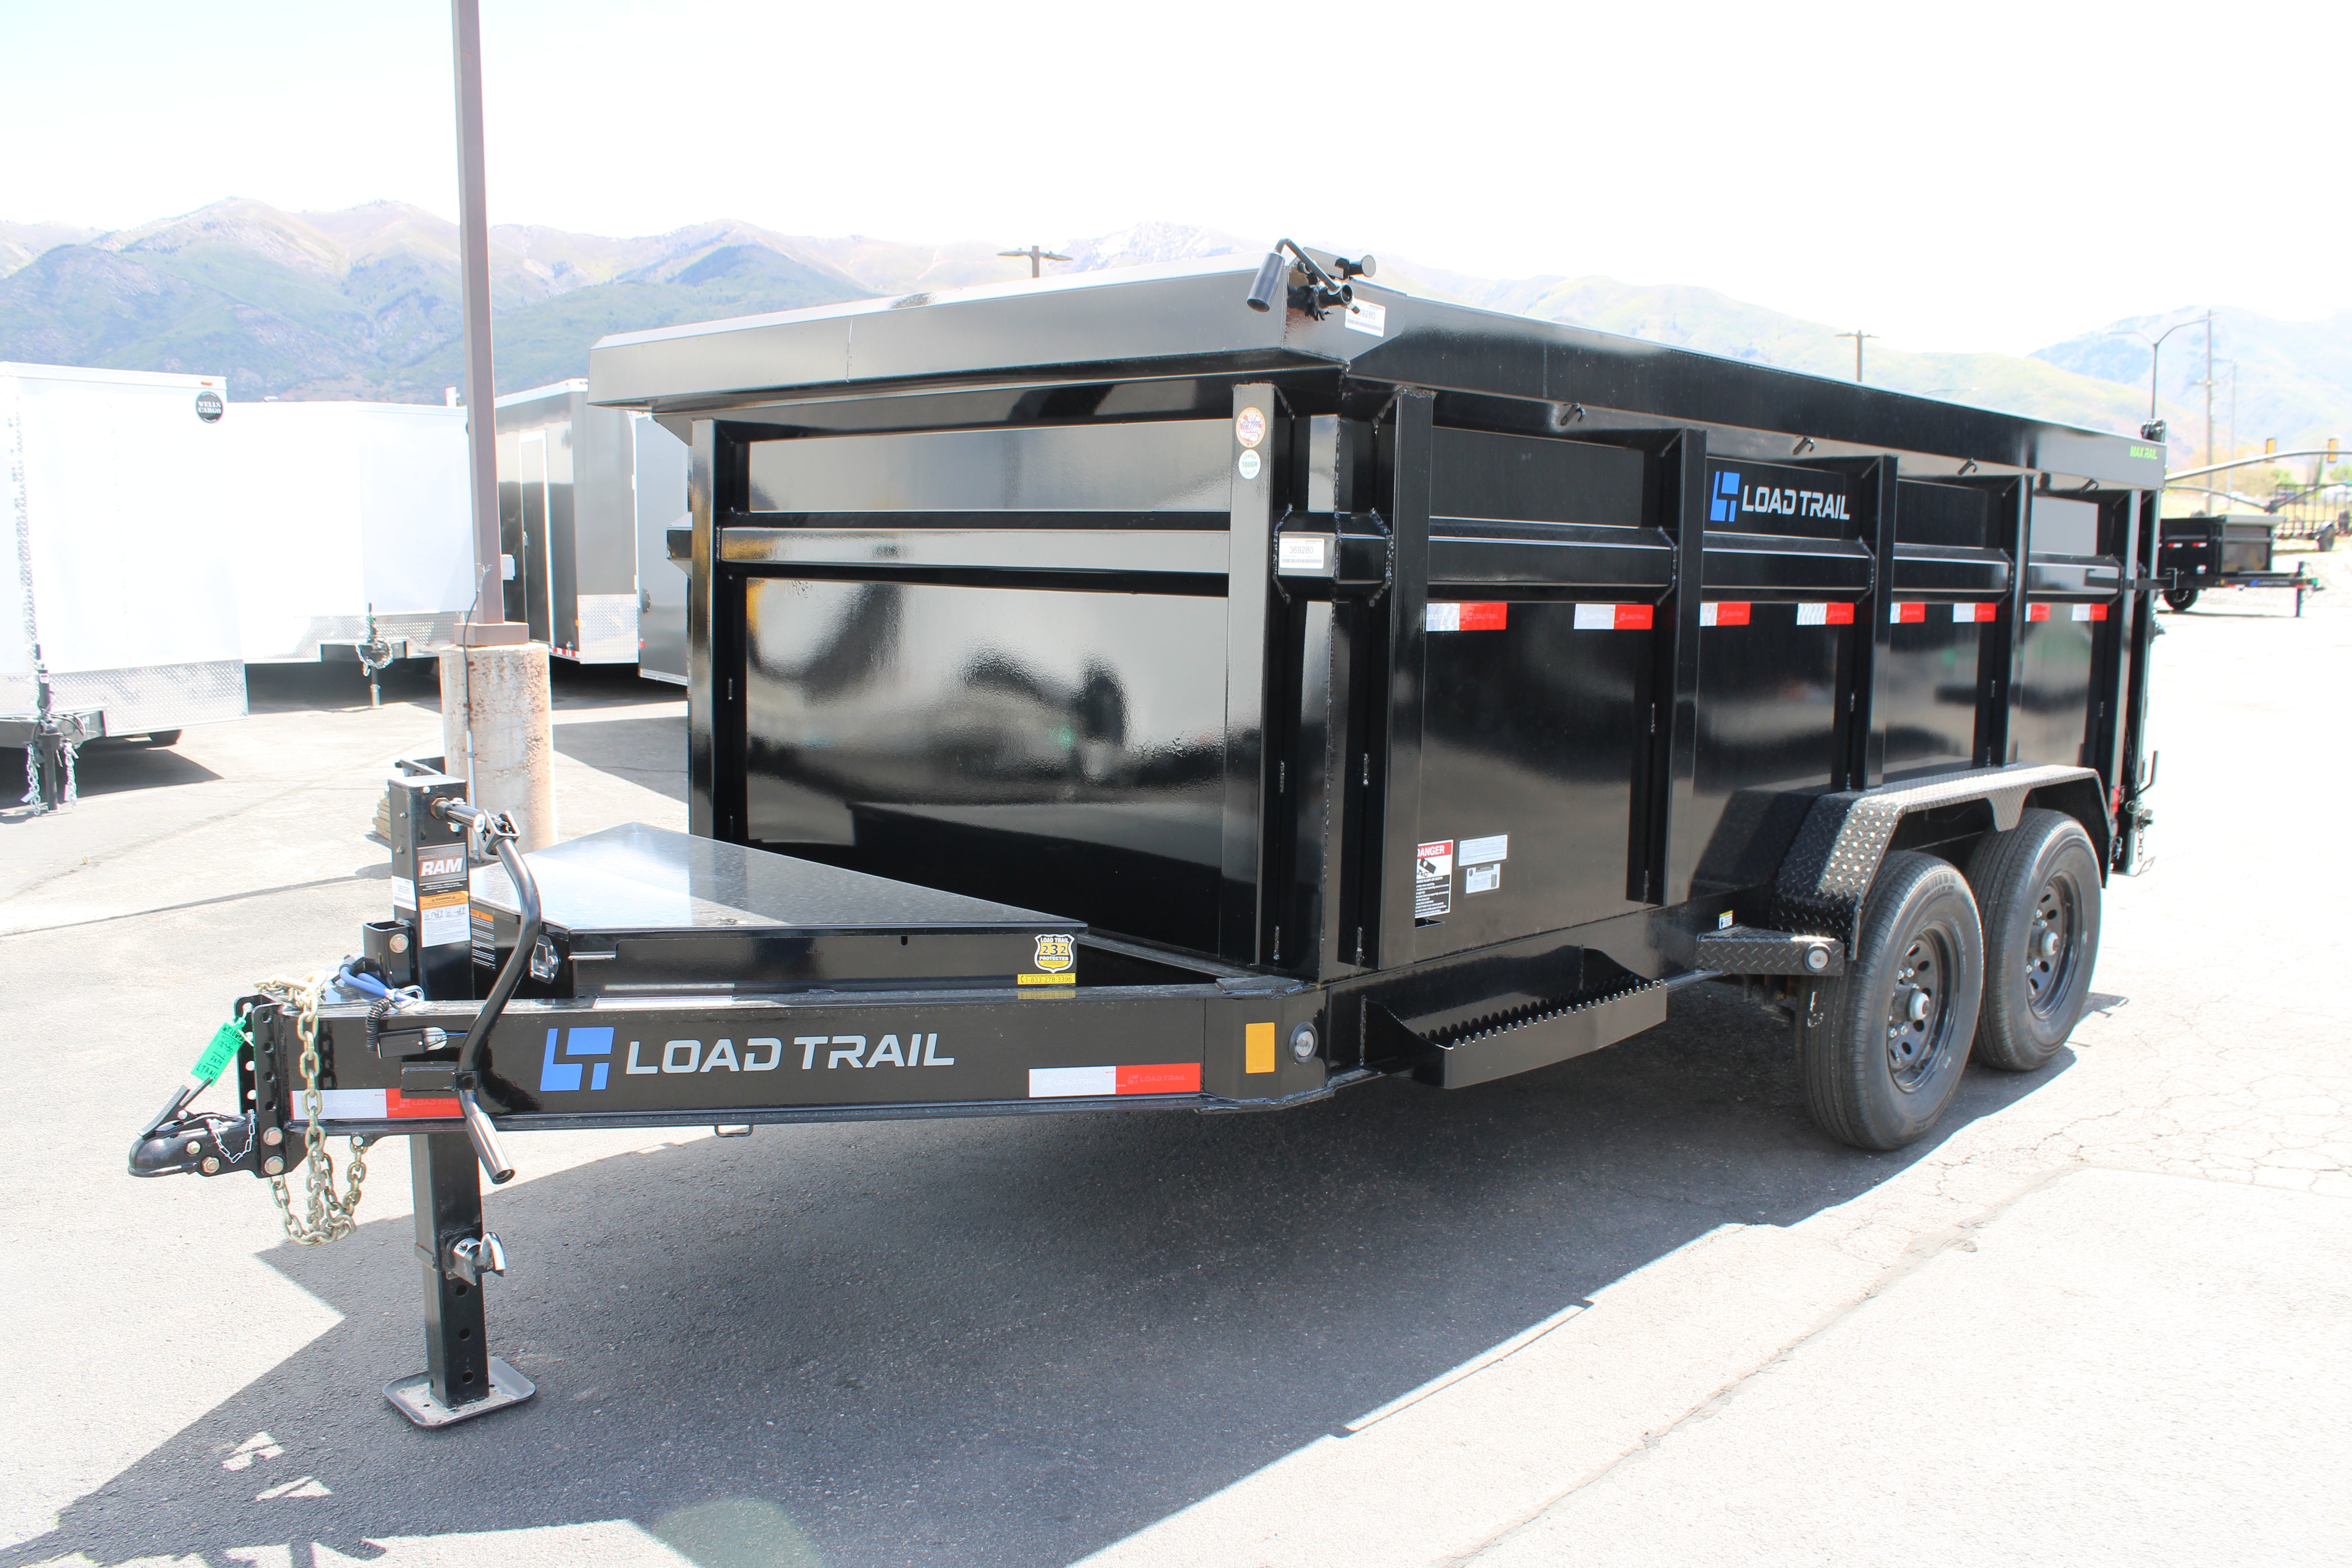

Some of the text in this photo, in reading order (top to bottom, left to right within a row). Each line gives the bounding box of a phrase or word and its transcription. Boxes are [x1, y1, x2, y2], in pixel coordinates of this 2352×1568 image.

[2130, 445, 2158, 460] MAX RAIL
[1742, 485, 1850, 520] LOAD TRAIL
[421, 858, 463, 876] RAM
[626, 1033, 955, 1075] LOAD TRAIL
